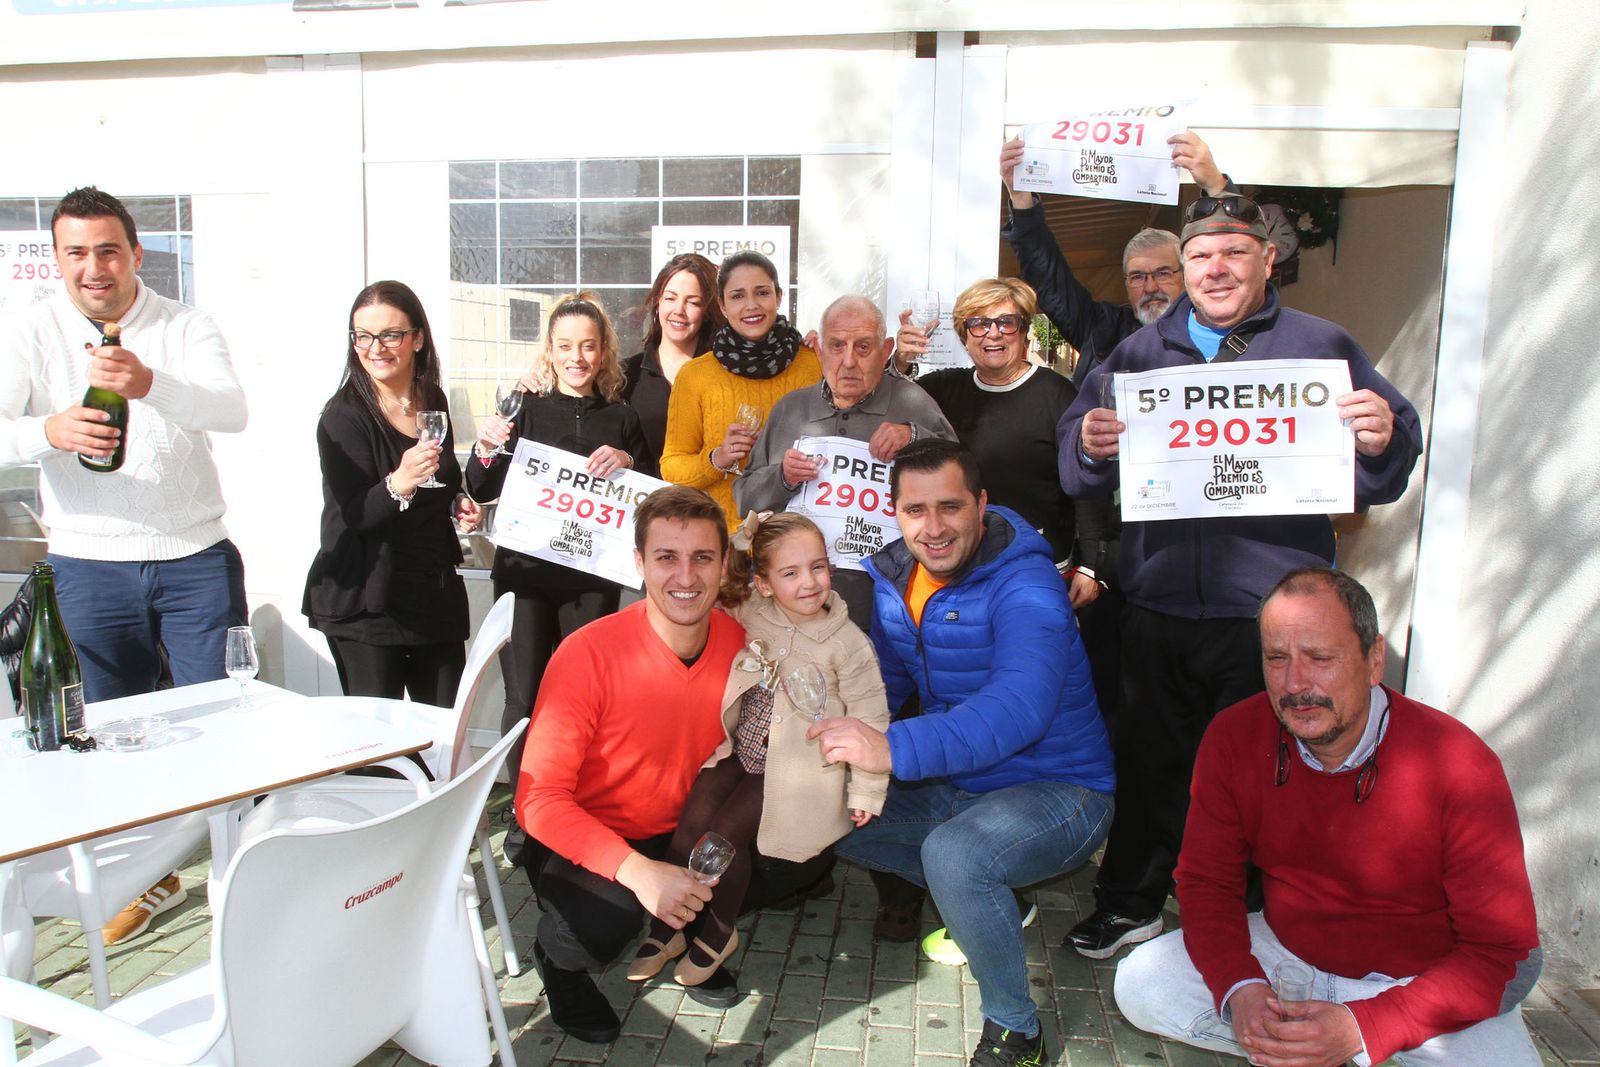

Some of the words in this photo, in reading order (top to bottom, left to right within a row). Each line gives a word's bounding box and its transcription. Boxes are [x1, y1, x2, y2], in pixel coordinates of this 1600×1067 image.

[1051, 120, 1145, 146] 29031
[1080, 157, 1105, 172] PREMIO
[1106, 165, 1116, 176] ES
[1088, 149, 1114, 165] MAYOR
[1072, 168, 1118, 185] COMPARTIRLO
[1138, 387, 1170, 413] 5º
[1184, 382, 1330, 410] PREMIO
[1168, 416, 1296, 449] 29031
[1213, 455, 1223, 464] EL
[1224, 454, 1259, 473] MAYOR
[1213, 465, 1249, 485] PREMIO
[1252, 470, 1264, 484] ES
[1204, 481, 1267, 501] COMPARTIRLO
[536, 488, 626, 529] 29031
[569, 521, 593, 538] MAYOR
[846, 515, 855, 524] EL
[854, 516, 882, 535] MAYOR
[560, 526, 584, 545] PREMIO
[584, 539, 593, 550] ES
[844, 524, 873, 544] PREMIO
[874, 536, 883, 547] ES
[550, 536, 593, 557] COMPARTIRLO
[344, 871, 404, 910] Cruzcampo
